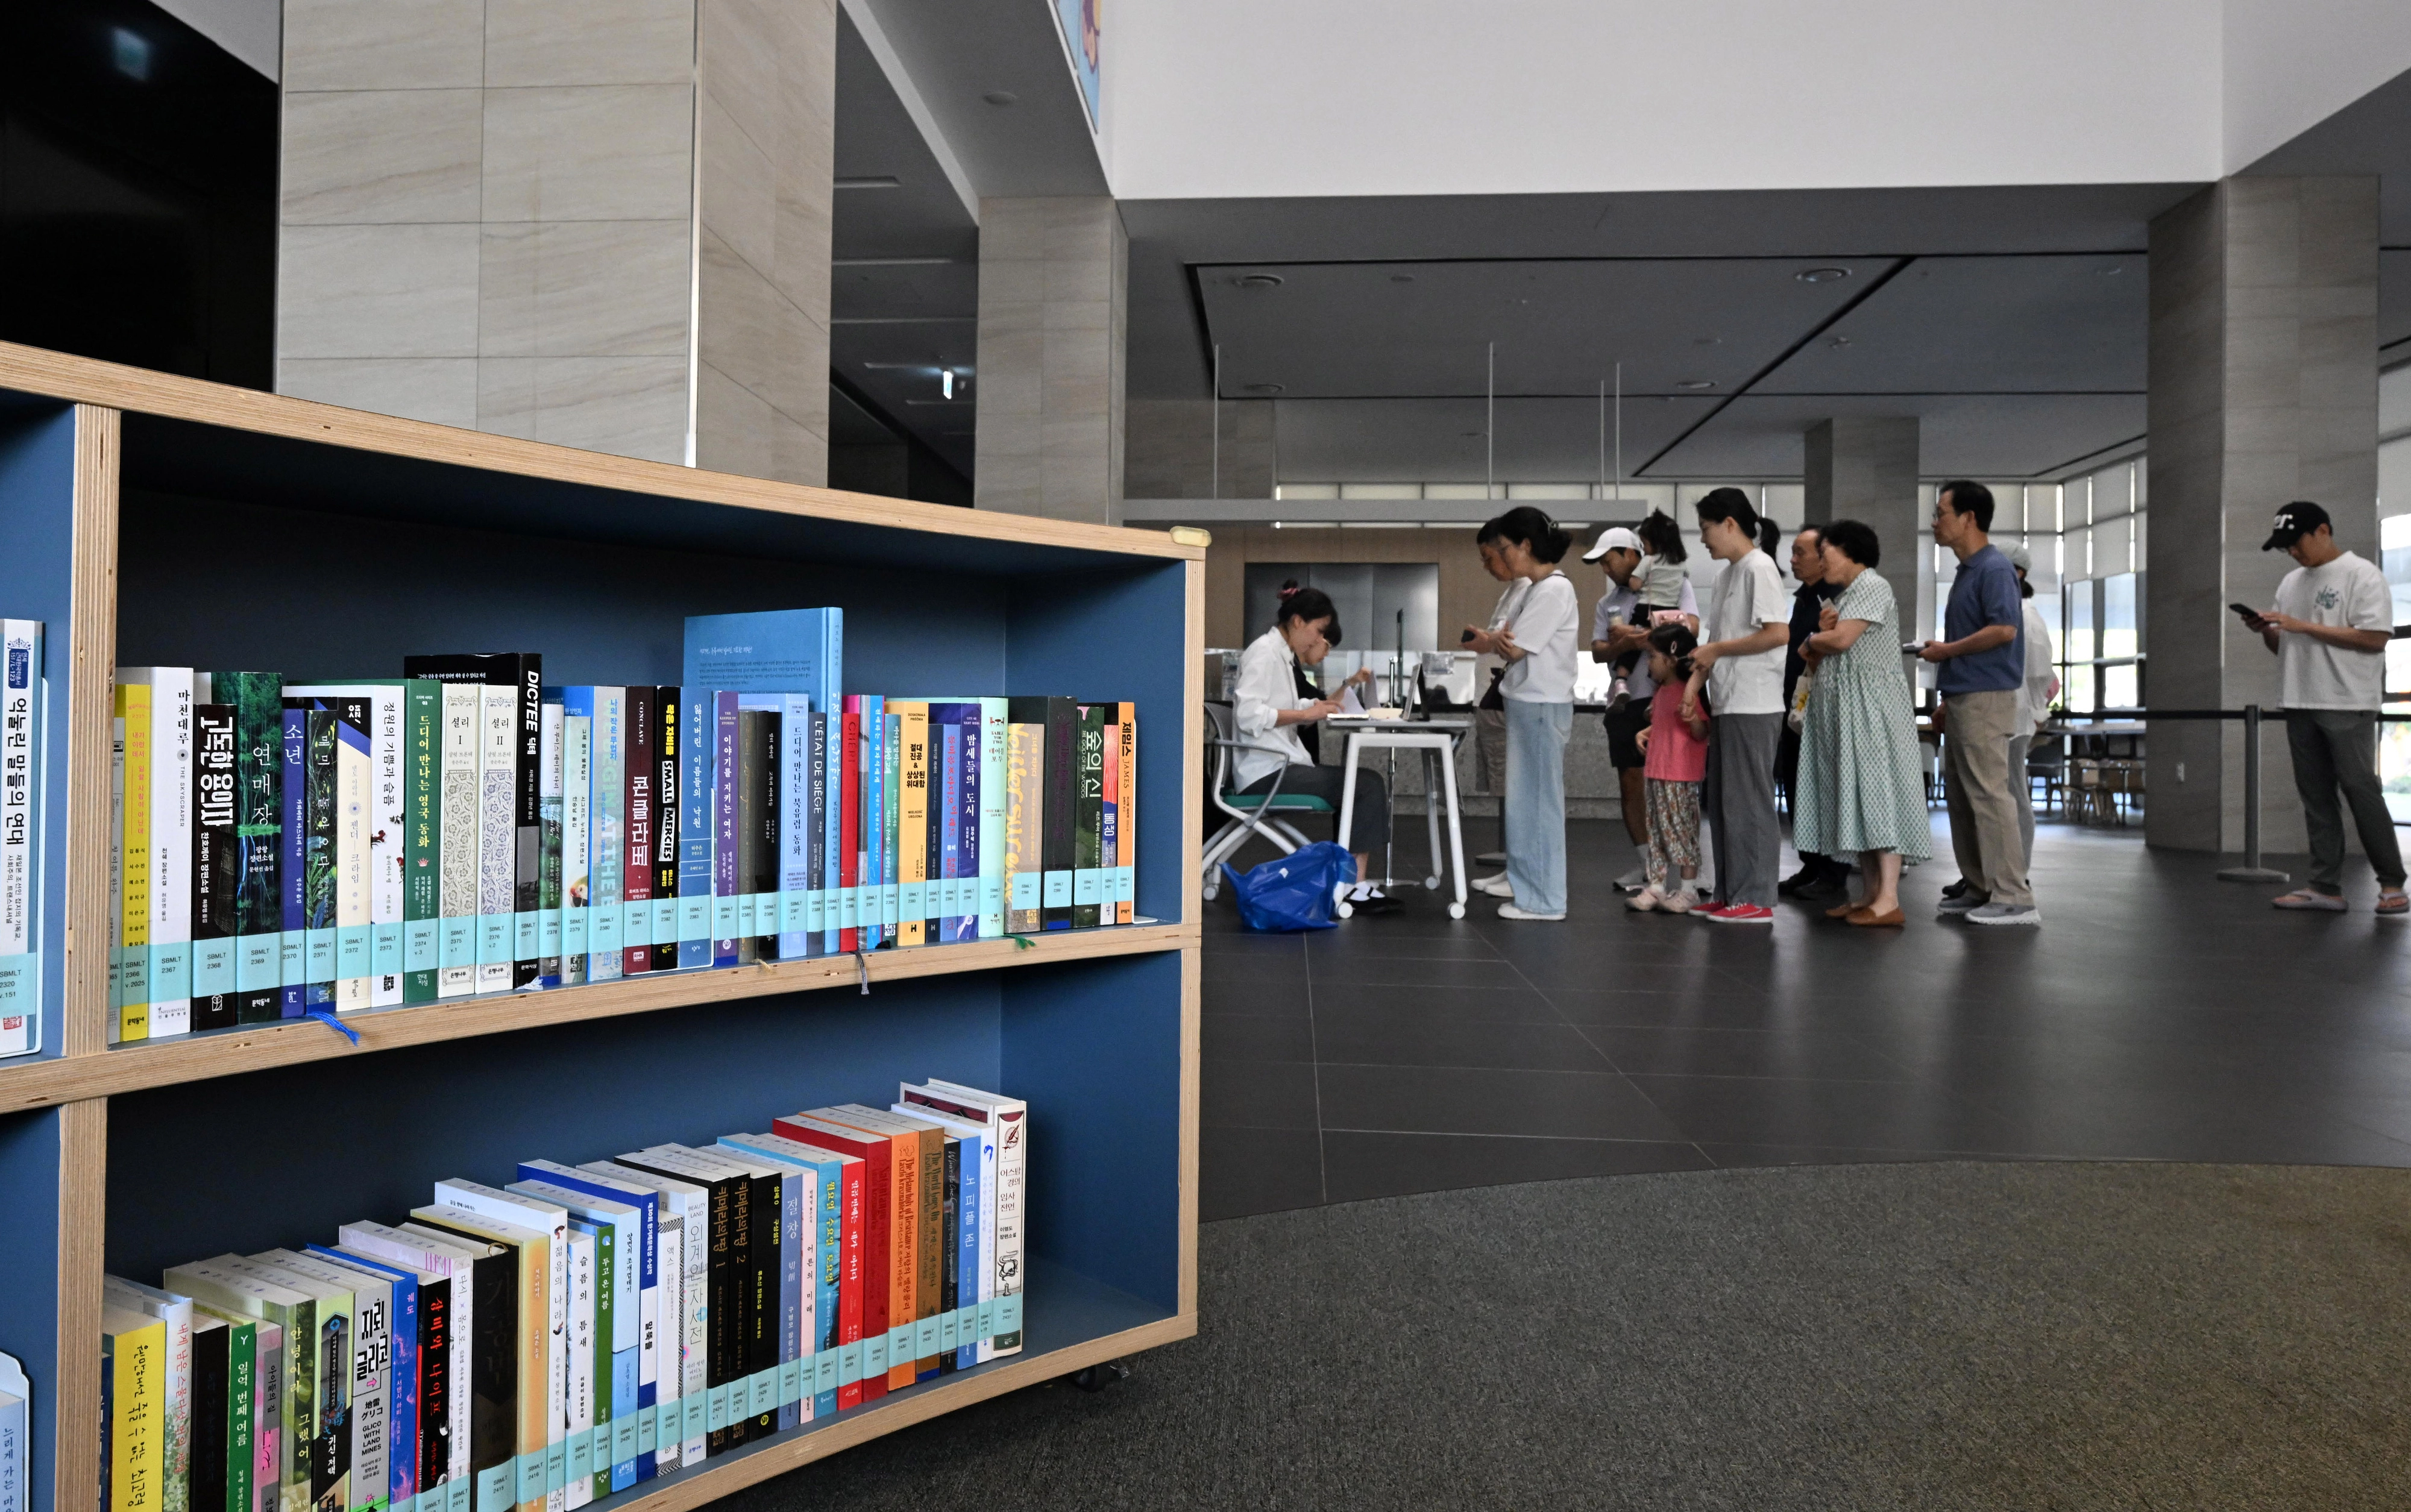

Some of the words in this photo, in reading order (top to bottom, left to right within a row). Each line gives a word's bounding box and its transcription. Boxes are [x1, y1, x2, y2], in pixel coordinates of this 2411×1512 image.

[526, 671, 538, 732] DICTEE
[8, 698, 27, 748] 억눌린
[178, 689, 190, 744] 마천대루
[384, 702, 395, 736] 정원의
[451, 717, 469, 728] 셜리
[492, 718, 509, 729] 셜리
[201, 717, 233, 768] 고독한
[284, 724, 303, 765] 소년
[419, 715, 430, 750] 드디어
[815, 721, 824, 757] L'ÉTAT
[1122, 723, 1131, 756] 제임스
[318, 736, 330, 765] 매미
[527, 737, 536, 754] 딕테
[1086, 731, 1102, 770] 숲의
[384, 742, 395, 778] 기쁨과
[418, 754, 430, 791] 만나는
[814, 761, 822, 776] DE
[966, 734, 976, 786] 밤새들의
[7, 755, 25, 806] 말들의
[253, 743, 272, 826] 연매장
[554, 776, 559, 789] 다리
[664, 762, 673, 801] SMALL
[1086, 778, 1101, 797] 신
[201, 774, 233, 826] 용의자
[384, 783, 394, 806] 슬픔
[814, 780, 823, 814] SIÈGE
[965, 793, 975, 817] 도시
[418, 795, 429, 820] 영국
[693, 806, 701, 828] 낙원
[7, 814, 24, 845] 연대
[318, 797, 329, 867] 돌아오다
[632, 776, 649, 866] 콘클라베
[723, 819, 732, 839] 여자
[1104, 814, 1114, 836] 동생
[418, 823, 429, 847] 동화
[664, 810, 673, 859] MERCIES
[793, 835, 800, 856] 동화
[250, 853, 273, 862] 장편소설
[252, 998, 269, 1006] 문학동네
[688, 1203, 706, 1211] BEAUTY
[734, 1181, 748, 1232] 키메라의
[1001, 1192, 1015, 1202] 임사
[787, 1197, 799, 1240] 절창
[734, 1232, 747, 1247] 땅
[667, 1246, 674, 1266] 액스
[691, 1224, 703, 1281] 외계인
[737, 1255, 746, 1264] 2
[579, 1257, 588, 1300] 슬픔의
[602, 1258, 609, 1276] 두고
[458, 1275, 467, 1297] 다시,
[554, 1295, 562, 1320] 나라
[602, 1292, 609, 1310] 여름
[806, 1291, 813, 1314] 미래
[362, 1301, 385, 1340] 지뢰
[430, 1297, 444, 1350] 장미와
[690, 1287, 703, 1345] 자서전
[177, 1323, 189, 1346] 내게
[458, 1315, 467, 1345] 몸으로
[579, 1320, 587, 1347] 틈새
[176, 1349, 188, 1372] 남은
[290, 1326, 301, 1393] 안녕이라
[357, 1334, 388, 1382] 글리코
[238, 1361, 248, 1386] 일억
[267, 1364, 277, 1400] 아이들의
[175, 1376, 188, 1422] 스물다섯
[429, 1363, 442, 1416] 나이프
[128, 1402, 148, 1422] 죽을
[236, 1391, 248, 1416] 번째
[267, 1403, 276, 1413] 집
[362, 1407, 383, 1420] グリコ
[365, 1398, 380, 1410] 地雷
[127, 1428, 146, 1437] 수
[236, 1421, 247, 1447] 여름
[299, 1413, 310, 1459] 그랬어
[363, 1421, 382, 1432] GLICO
[364, 1429, 380, 1438] WITH
[4, 1428, 13, 1460] 느리게
[130, 1441, 146, 1463] 없는
[362, 1445, 382, 1455] MINES
[363, 1437, 380, 1447] LAND
[4, 1467, 13, 1489] 가는
[127, 1469, 147, 1507] 최고령
[453, 1489, 468, 1499] SBMLT
